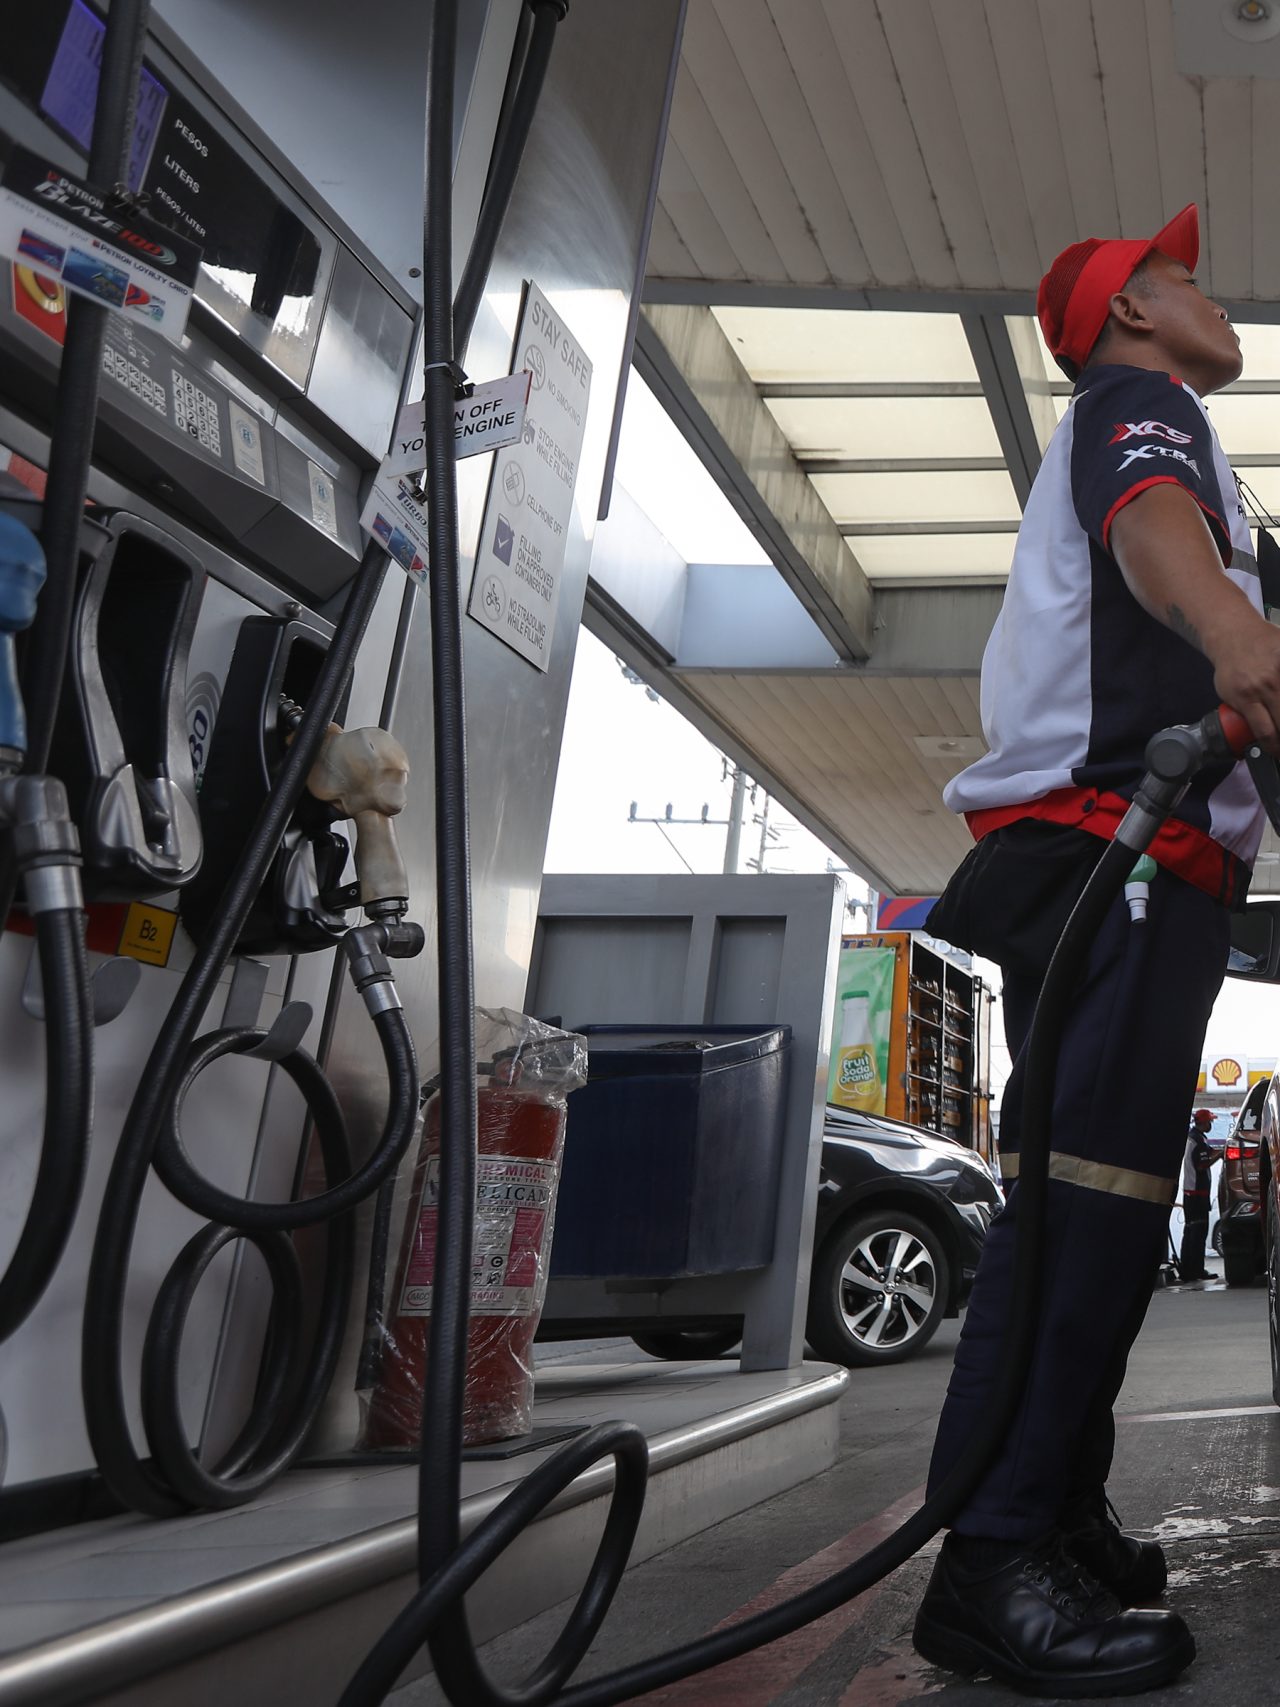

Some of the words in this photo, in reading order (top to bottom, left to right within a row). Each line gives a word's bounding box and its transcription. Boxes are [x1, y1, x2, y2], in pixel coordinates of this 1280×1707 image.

[175, 119, 208, 157] PESOS
[58, 177, 105, 210] PETRON
[164, 154, 199, 194] LITERS
[156, 186, 182, 214] PESOS
[185, 214, 206, 237] LITER
[99, 243, 133, 267] PETRON
[133, 261, 168, 285] LOYALTY
[168, 281, 189, 296] CARD
[531, 301, 561, 349] STAY
[561, 339, 588, 389] SAFE
[470, 399, 503, 419] OFF
[547, 378, 556, 396] NO
[556, 391, 582, 427] SMOKING
[455, 411, 516, 440] ENGINE
[1117, 420, 1193, 444] XCS
[536, 442, 553, 468] WHILE
[552, 460, 573, 489] FILLING
[537, 427, 553, 450] STOP
[553, 444, 575, 473] ENGINE
[397, 484, 428, 526] TURBO
[526, 494, 554, 530] CELLPHONE
[553, 523, 563, 537] OFF
[520, 534, 542, 564] FILLING
[514, 562, 542, 595] CONTAINERS
[541, 586, 552, 603] ONLY
[517, 549, 526, 565] ON
[525, 557, 554, 589] APPROVED
[507, 612, 524, 636] WHILE
[523, 626, 543, 651] FILLING
[509, 598, 518, 613] NO
[517, 605, 546, 636] STRADDLING
[139, 919, 158, 942] B2
[477, 1185, 548, 1202] ELICAN
[472, 1291, 505, 1300] RADING
